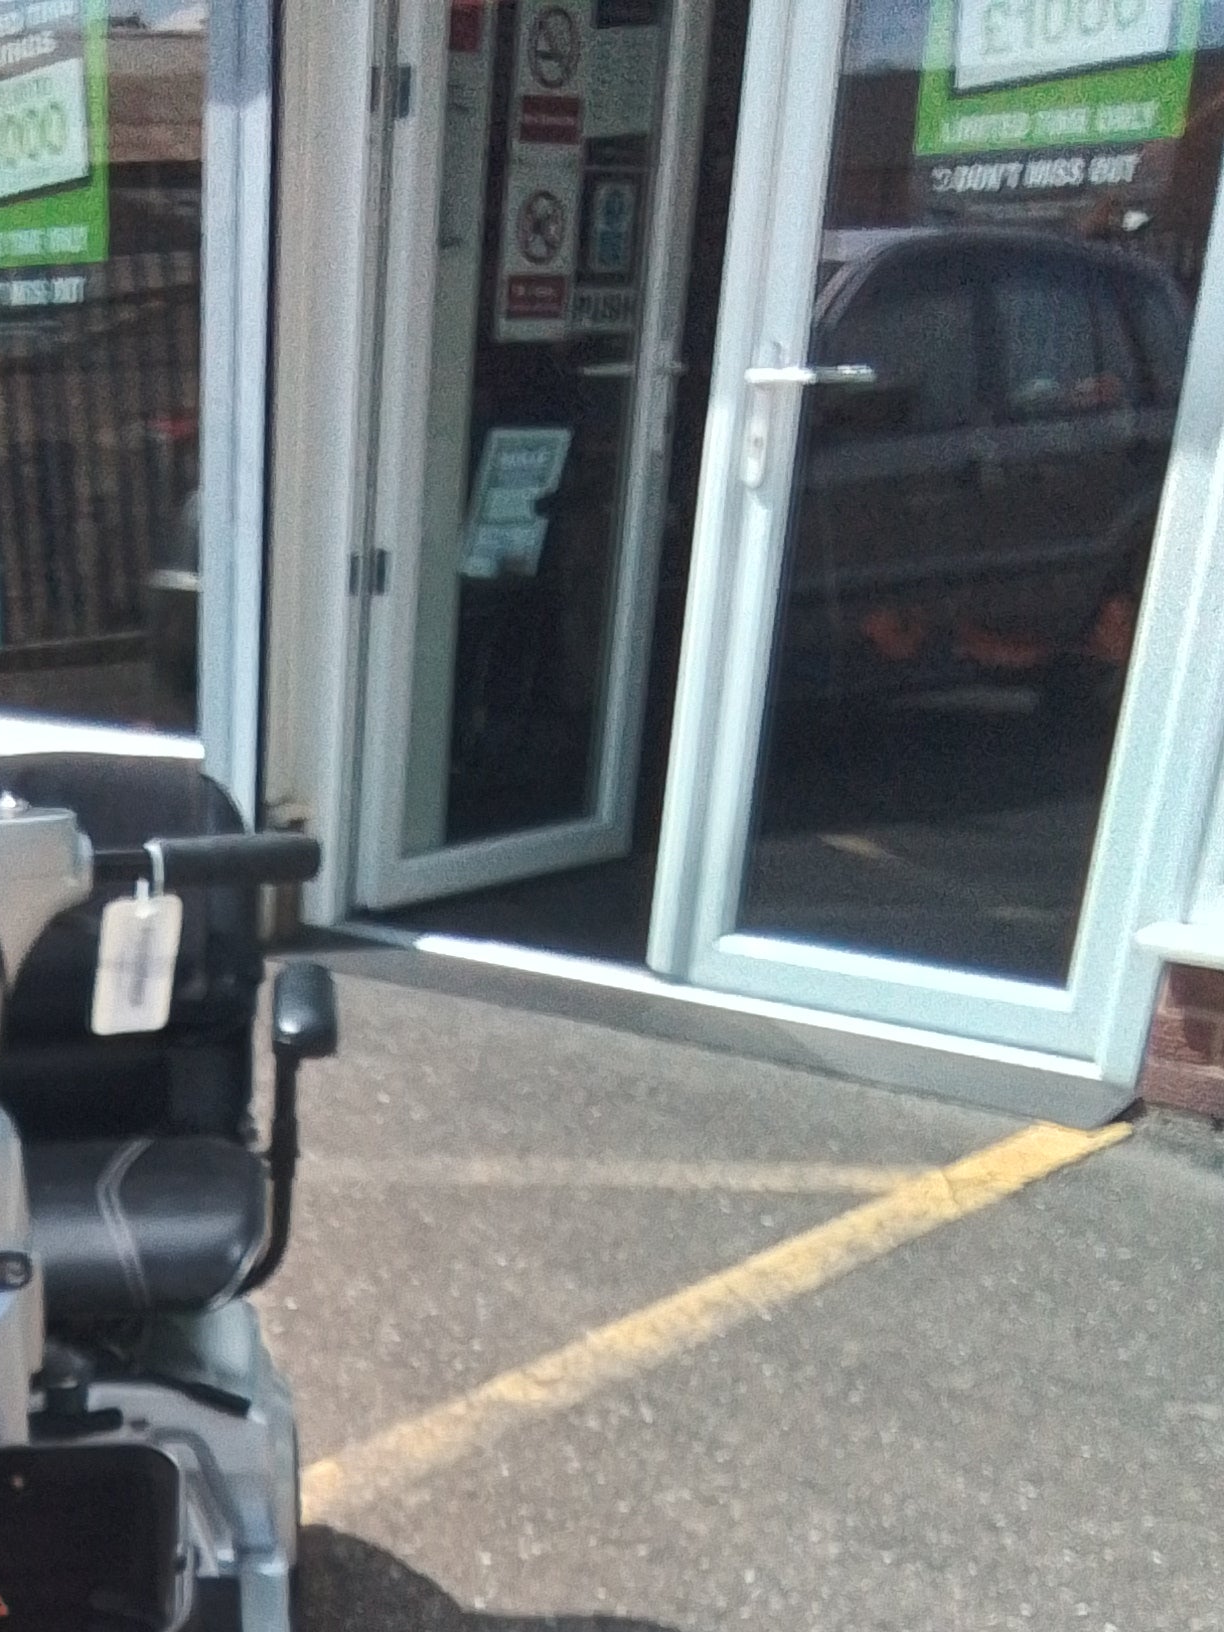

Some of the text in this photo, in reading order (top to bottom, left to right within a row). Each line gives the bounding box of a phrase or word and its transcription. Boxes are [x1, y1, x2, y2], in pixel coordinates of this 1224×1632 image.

[942, 99, 1162, 143] LIMITED TIME ONLY
[1023, 157, 1087, 189] MISS
[1087, 153, 1143, 184] OUT
